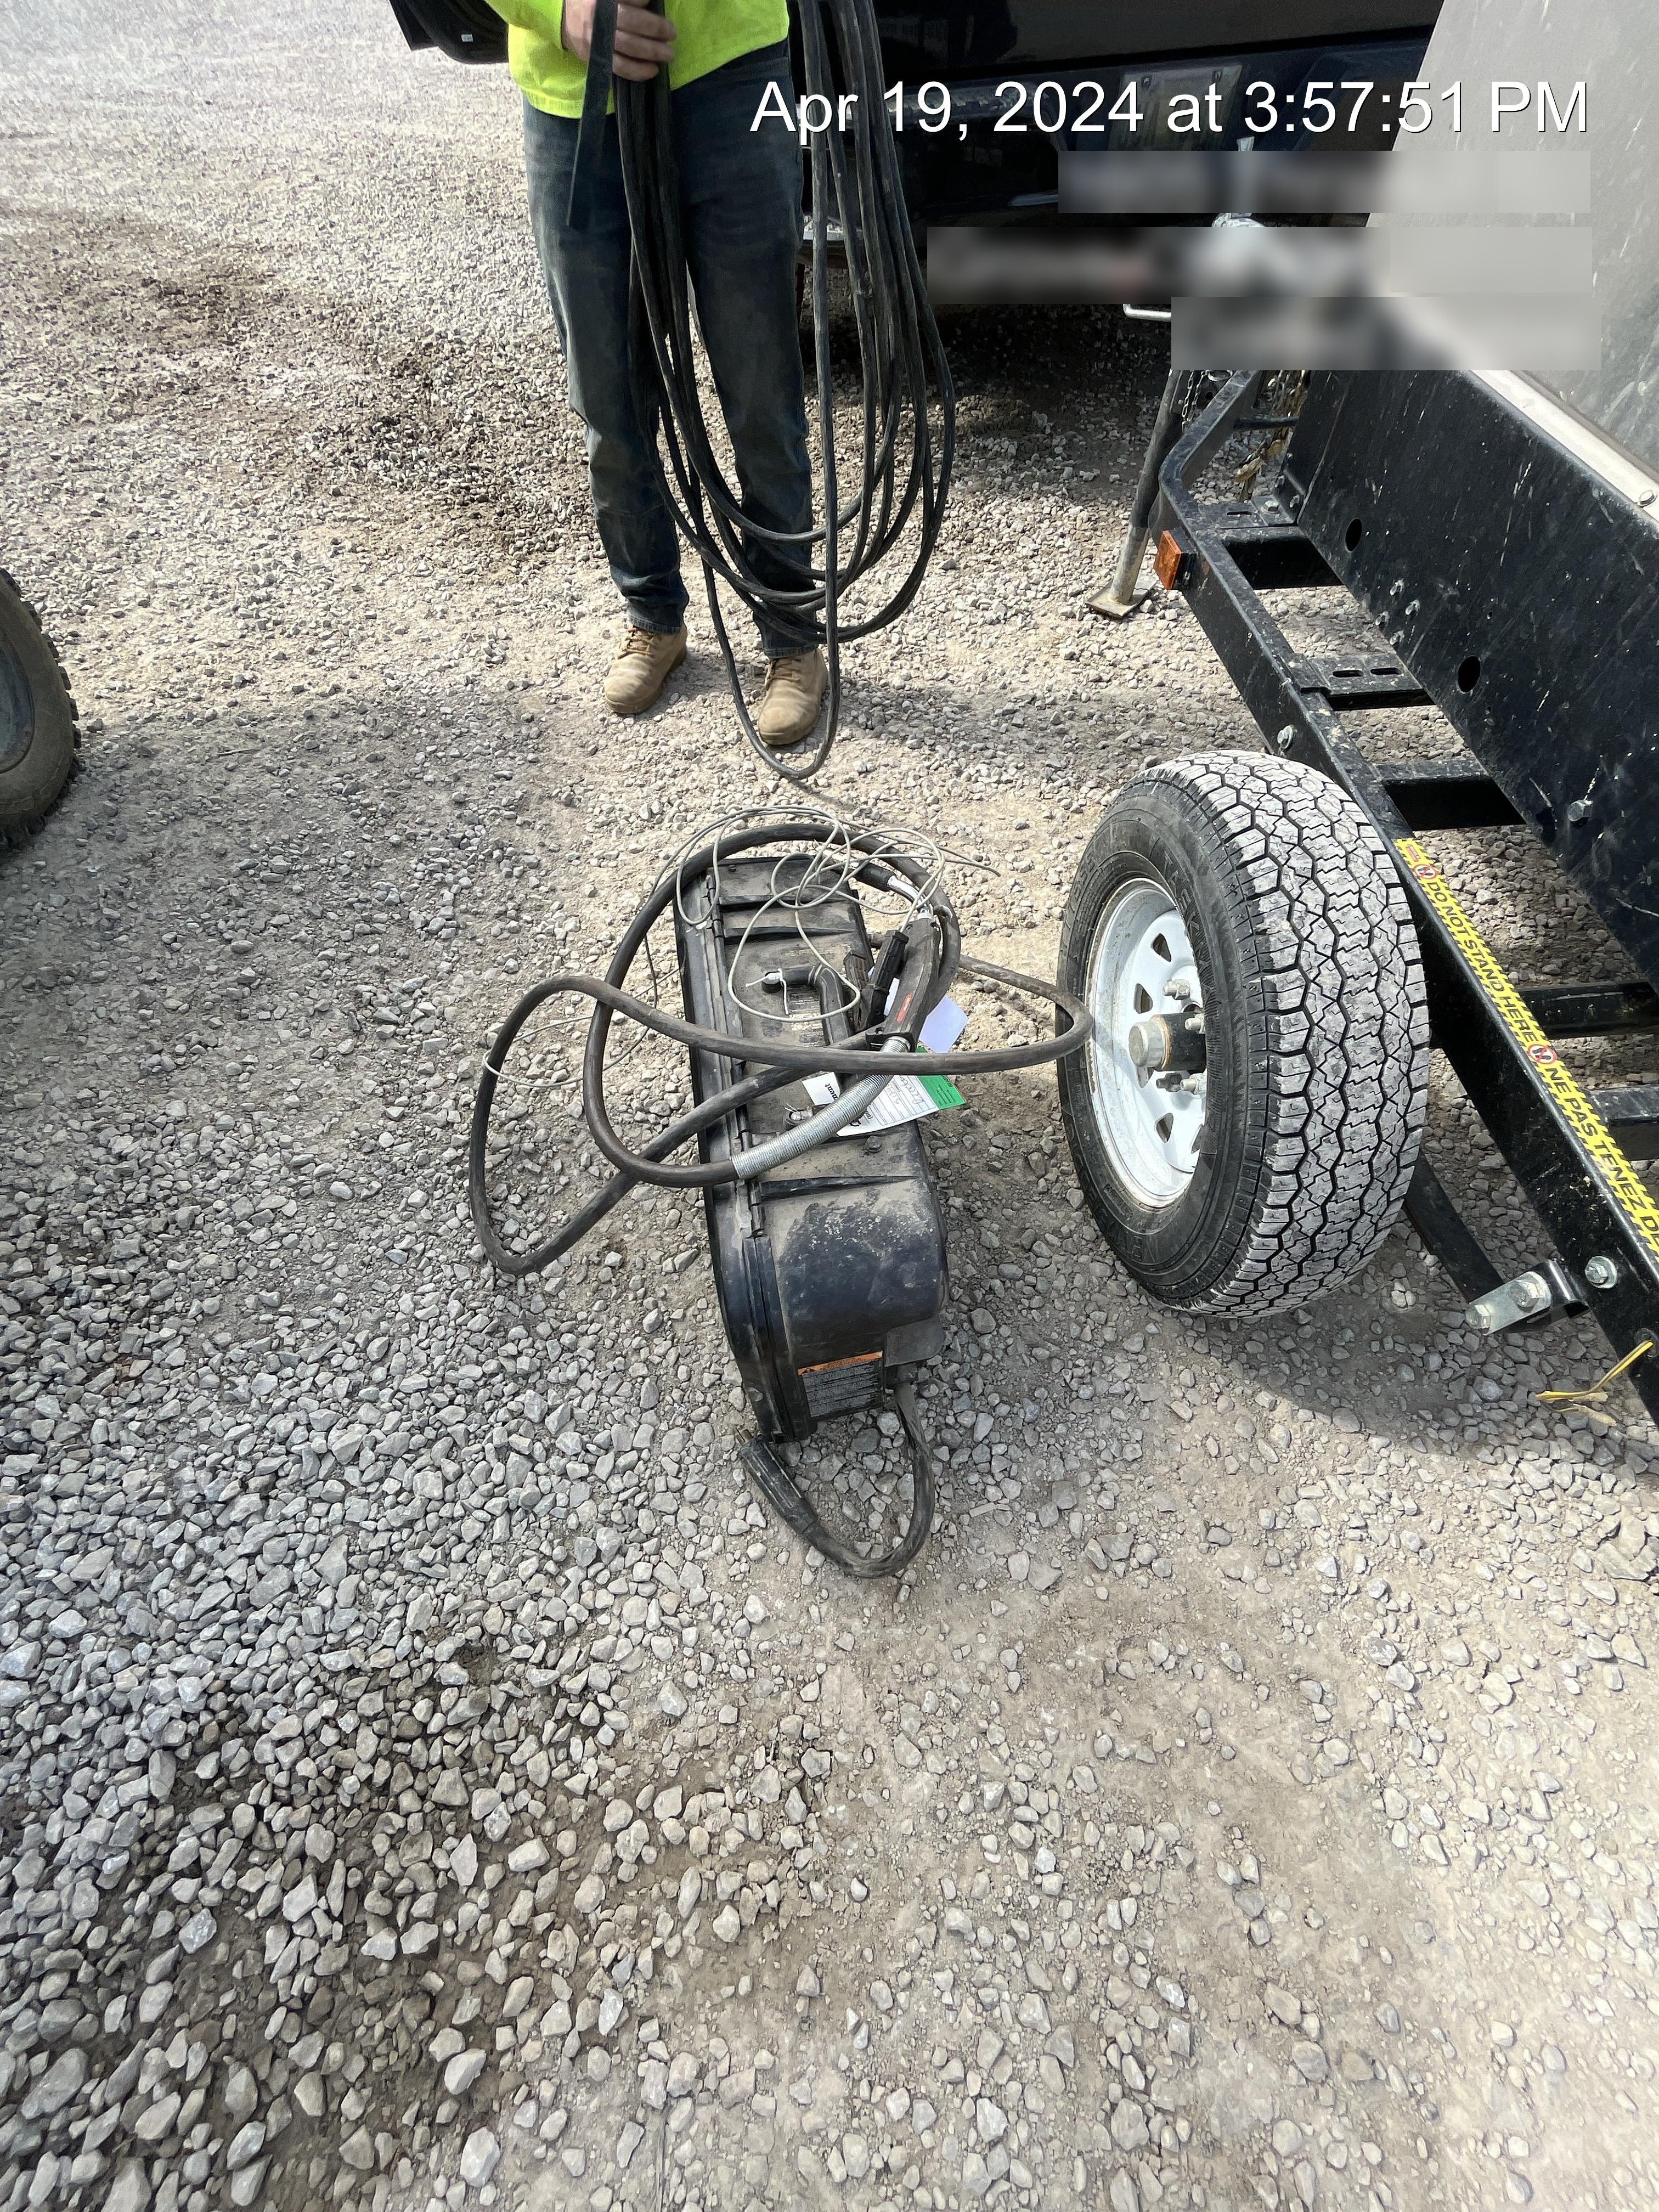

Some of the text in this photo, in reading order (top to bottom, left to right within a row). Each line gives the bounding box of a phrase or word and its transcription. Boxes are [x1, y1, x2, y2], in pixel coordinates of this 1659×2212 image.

[1426, 882, 1539, 1042] DO NOT STAND HERE
[1545, 1067, 1572, 1094] NE
[1566, 1098, 1599, 1137] PAS
[1593, 1140, 1647, 1210] TENEZ
